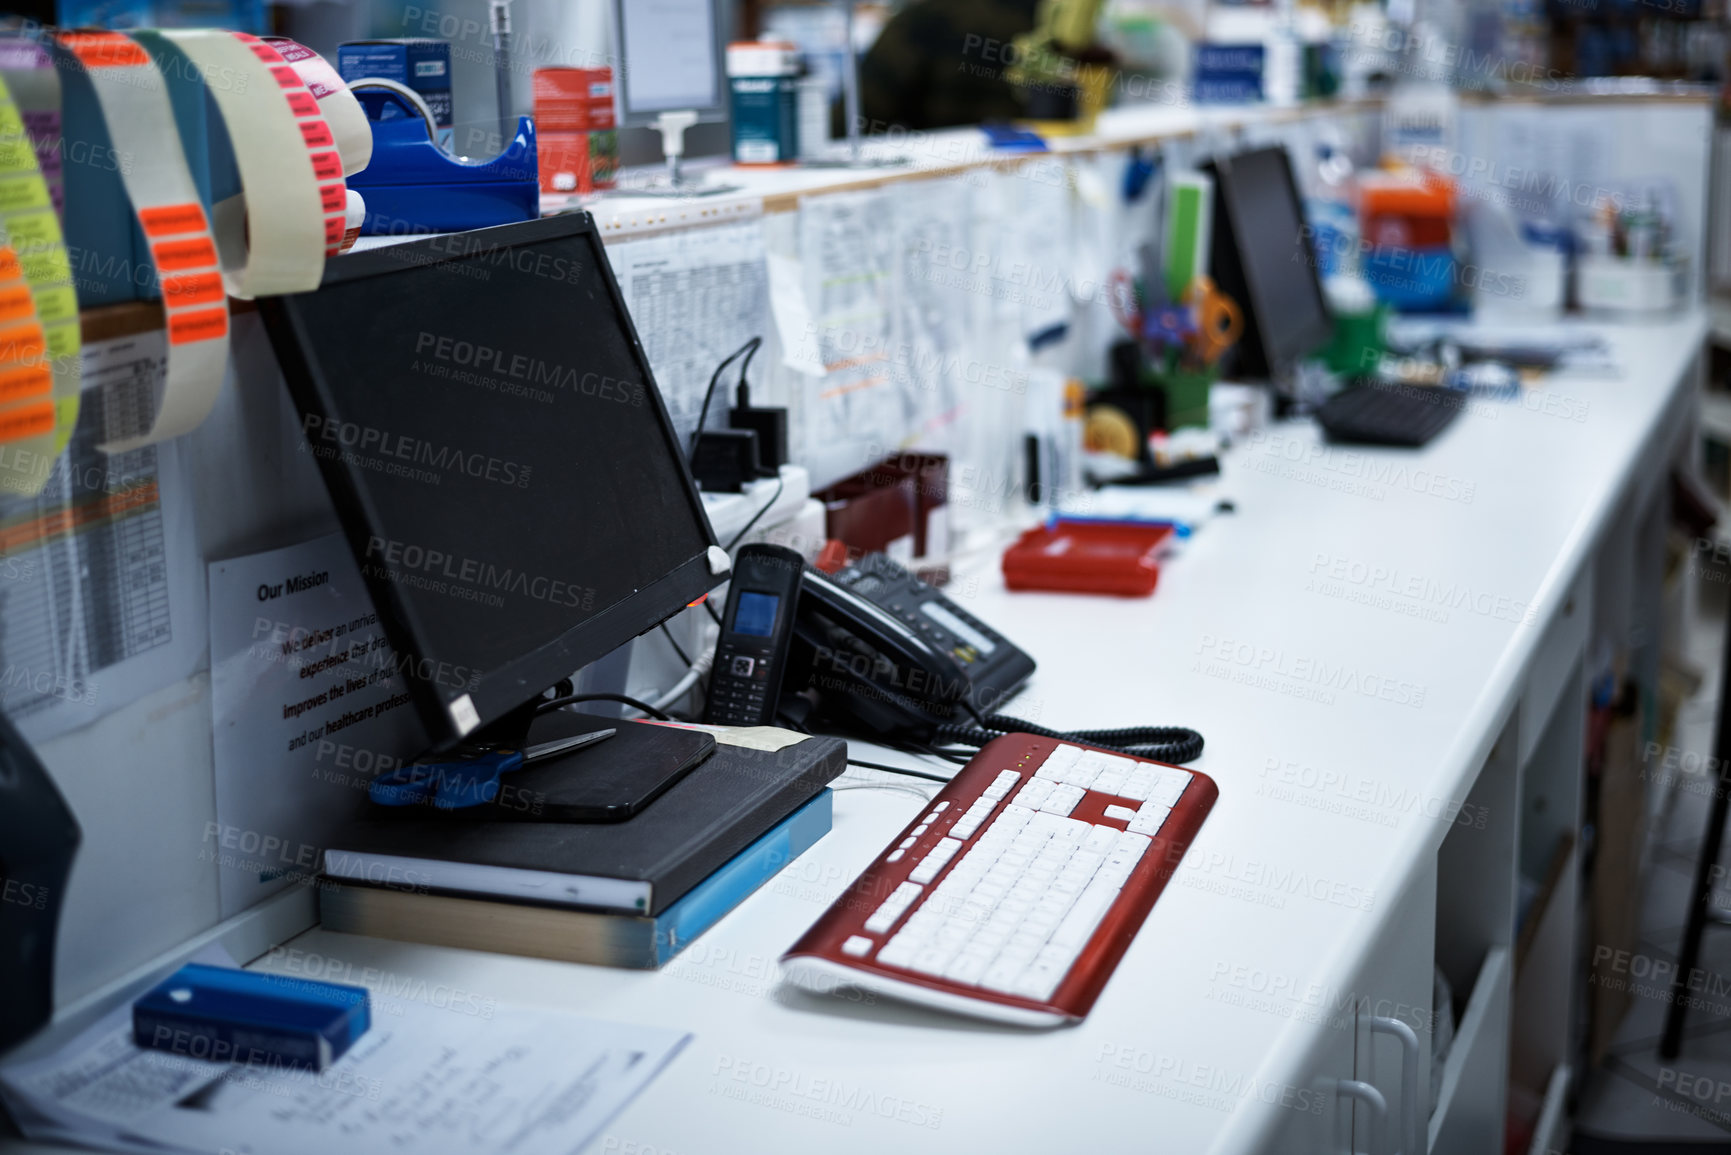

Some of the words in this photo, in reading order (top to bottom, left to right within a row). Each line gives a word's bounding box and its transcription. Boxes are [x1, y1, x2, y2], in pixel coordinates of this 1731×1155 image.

[258, 584, 283, 602] Our
[286, 571, 329, 595] Mission
[282, 640, 299, 655] We
[302, 627, 335, 650] deliver
[335, 624, 347, 637] an
[300, 650, 349, 679] experience
[351, 641, 370, 658] that
[371, 636, 390, 651] dra
[283, 693, 327, 719] improves
[329, 684, 344, 701] the
[346, 677, 367, 694] lives
[368, 668, 378, 684] of
[379, 667, 394, 679] our
[289, 730, 307, 751] and
[308, 727, 324, 743] our
[326, 706, 373, 735] healthcare
